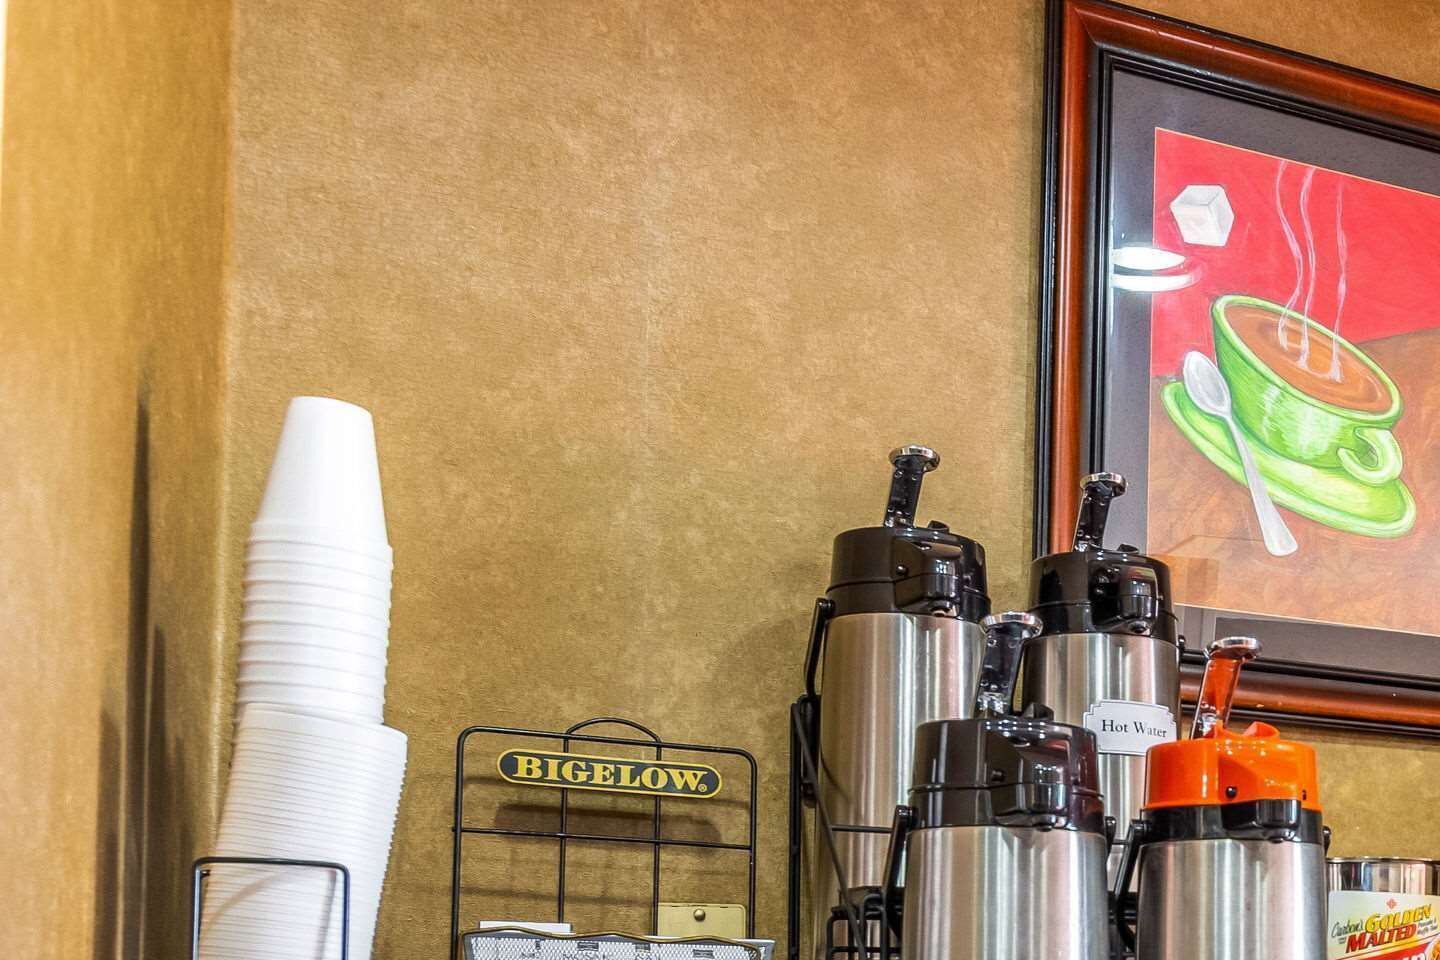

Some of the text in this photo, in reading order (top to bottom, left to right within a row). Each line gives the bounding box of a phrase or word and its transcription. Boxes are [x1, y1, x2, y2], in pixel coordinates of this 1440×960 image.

[1102, 719, 1168, 738] Hot Water
[512, 755, 708, 792] BIGELOW
[1365, 904, 1431, 933] GOLDEN
[1345, 924, 1417, 953] MALTED
